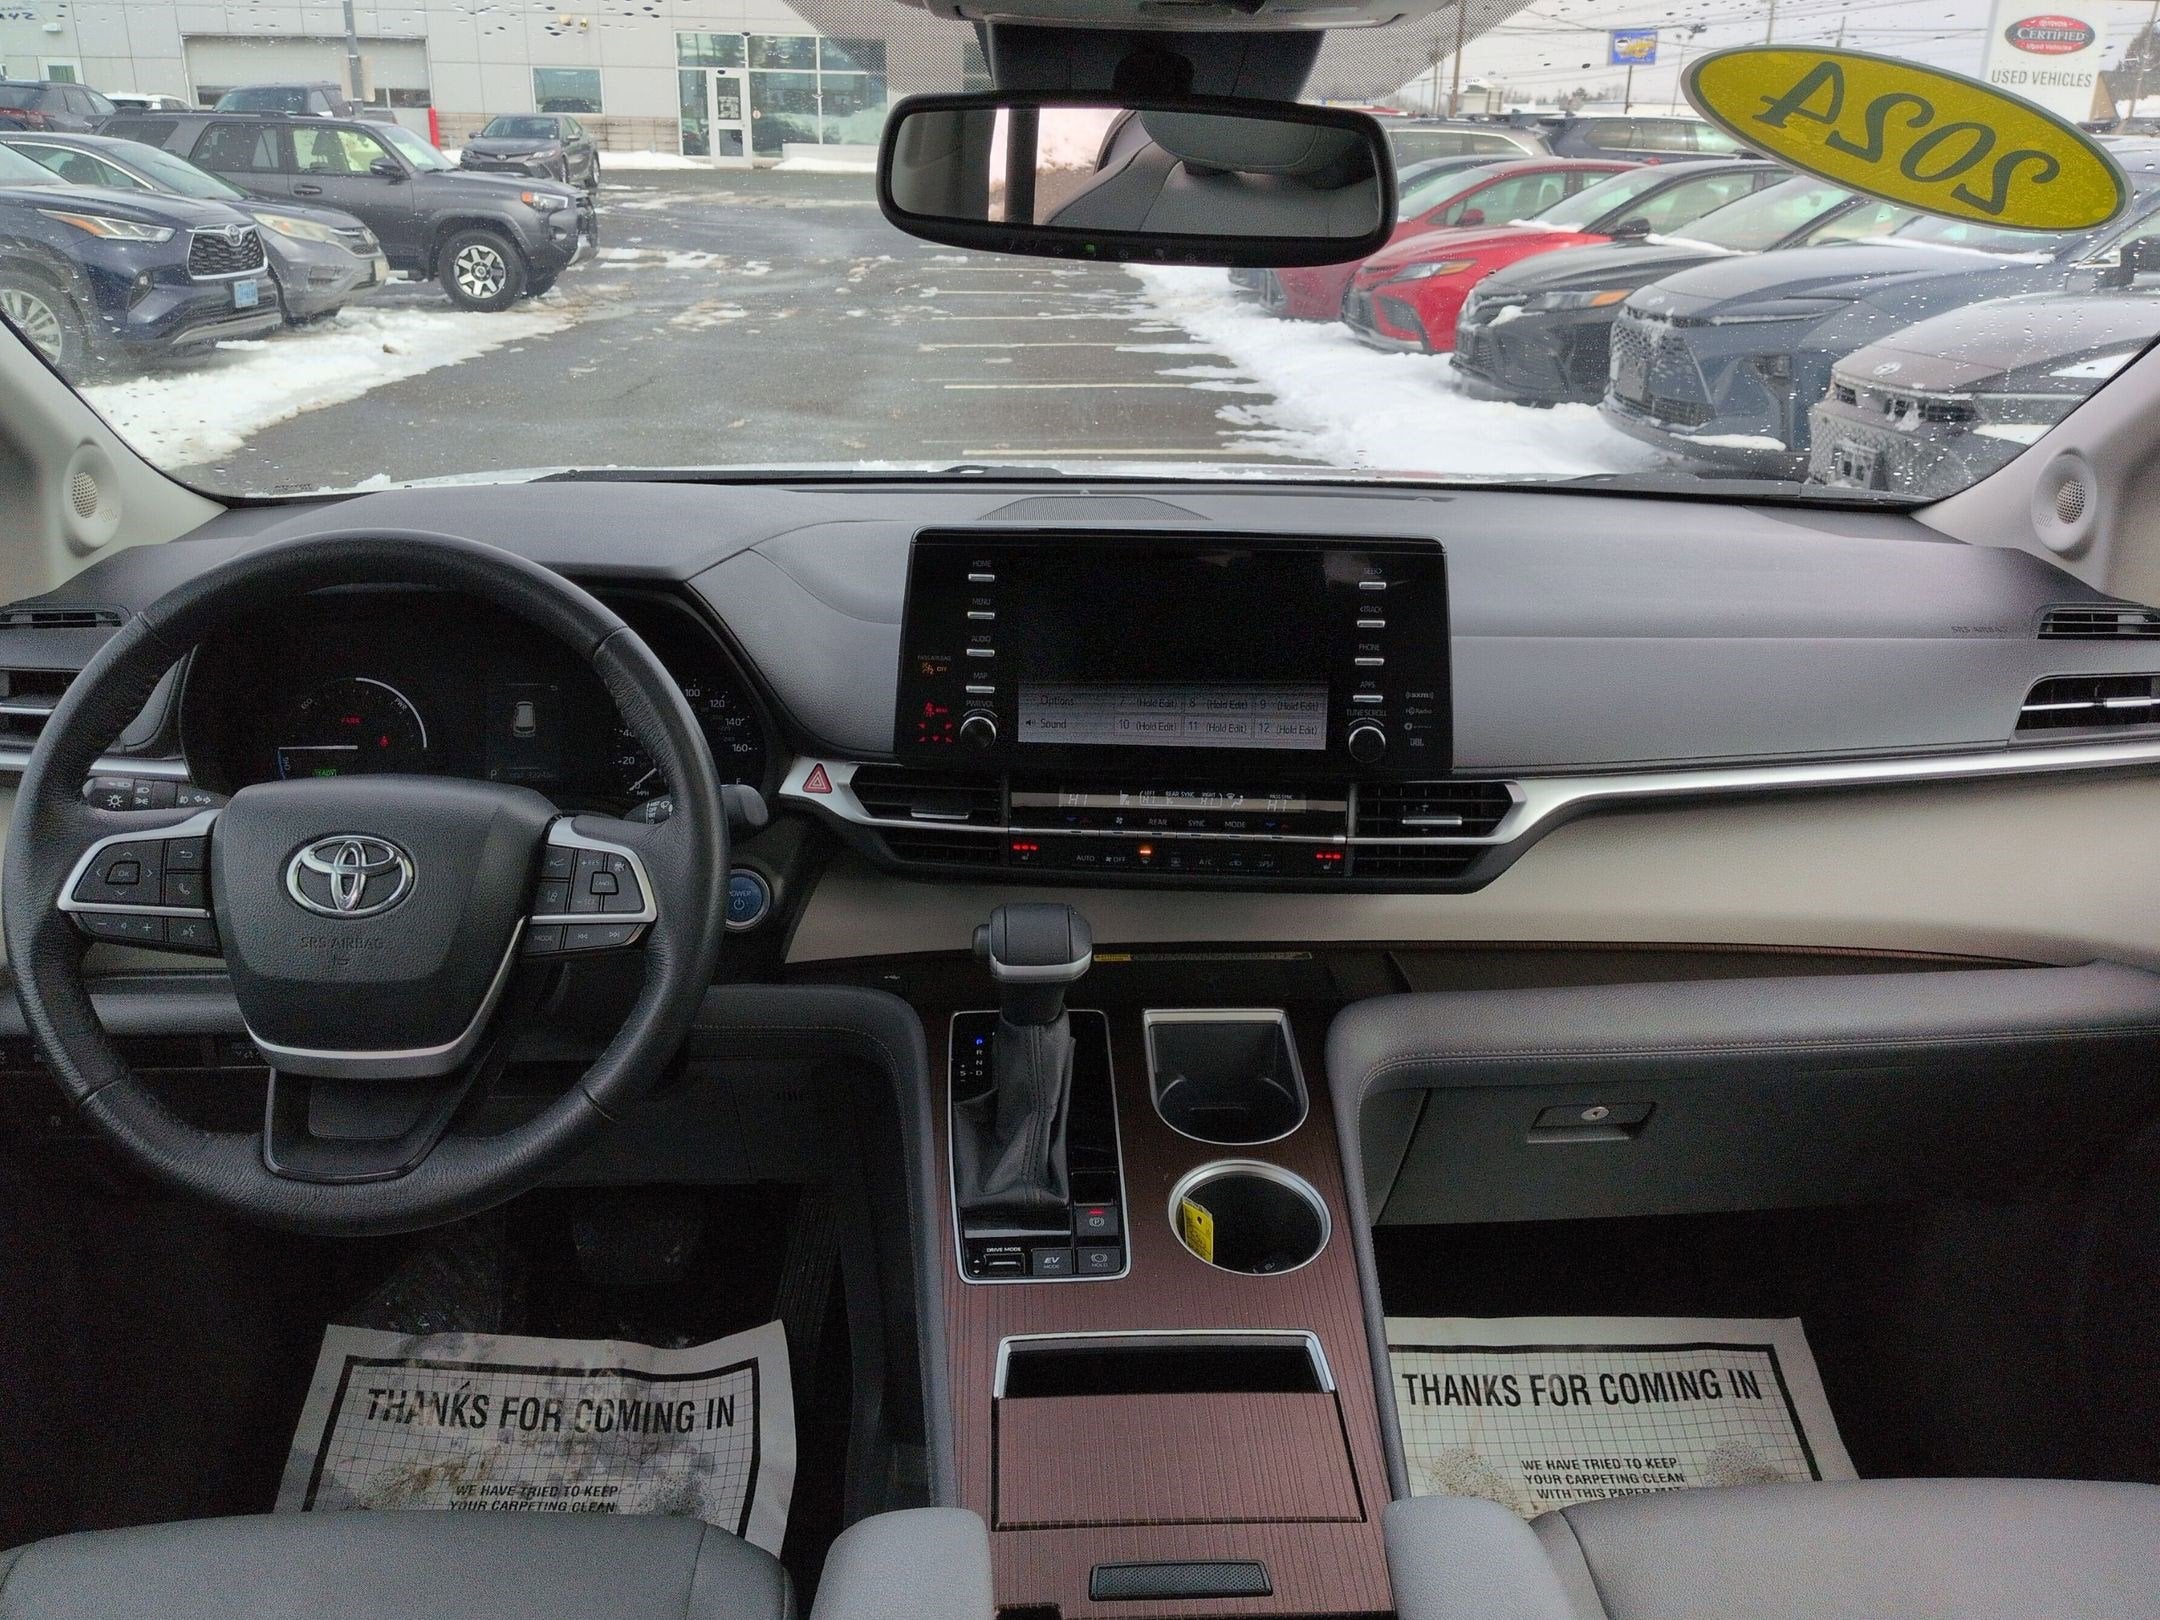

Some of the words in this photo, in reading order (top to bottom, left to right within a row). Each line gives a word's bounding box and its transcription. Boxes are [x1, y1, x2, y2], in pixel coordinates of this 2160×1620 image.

[1991, 70, 2027, 84] USED
[2032, 71, 2092, 87] VEHICLES
[684, 688, 701, 697] 100
[709, 700, 725, 708] 120
[725, 718, 742, 727] 140
[1040, 718, 1067, 729] Sound
[1118, 720, 1130, 730] 10
[1136, 721, 1157, 733] (Hold
[1188, 721, 1198, 731] 11
[1206, 722, 1227, 734] (Hold
[1258, 722, 1270, 733] 12
[1276, 724, 1298, 735] (Hold
[1299, 725, 1318, 736] Edit)
[732, 744, 748, 753] 160
[623, 756, 635, 765] 20
[490, 769, 497, 780] P
[1148, 818, 1168, 826] REAR
[1187, 820, 1206, 828] SYNC
[1402, 1373, 1521, 1408] THANKS
[1531, 1374, 1591, 1407] FOR
[1599, 1369, 1723, 1405] COMING
[1729, 1369, 1763, 1400] IN
[367, 1388, 490, 1430] THANKS
[498, 1396, 561, 1433] FOR
[574, 1396, 695, 1434] COMING
[706, 1395, 735, 1431] IN
[1521, 1459, 1543, 1471] WE
[1546, 1459, 1580, 1470] HAVE
[1581, 1458, 1621, 1470] TRIED
[1623, 1458, 1642, 1469] TO
[1644, 1457, 1677, 1469] KEEP
[1525, 1474, 1562, 1485] YOUR
[1566, 1474, 1640, 1485] CARPETING
[1643, 1473, 1685, 1484] CLEAN
[456, 1485, 477, 1496] WE
[480, 1485, 516, 1497] HAVE
[520, 1485, 559, 1497] TRIED
[563, 1485, 579, 1498] TO
[583, 1485, 618, 1497] KEEP
[1536, 1489, 1572, 1499] WITH
[1576, 1488, 1606, 1499] THIS
[450, 1500, 487, 1511] YOUR
[491, 1500, 568, 1512] CARPETING
[571, 1502, 617, 1513] CLEAN
